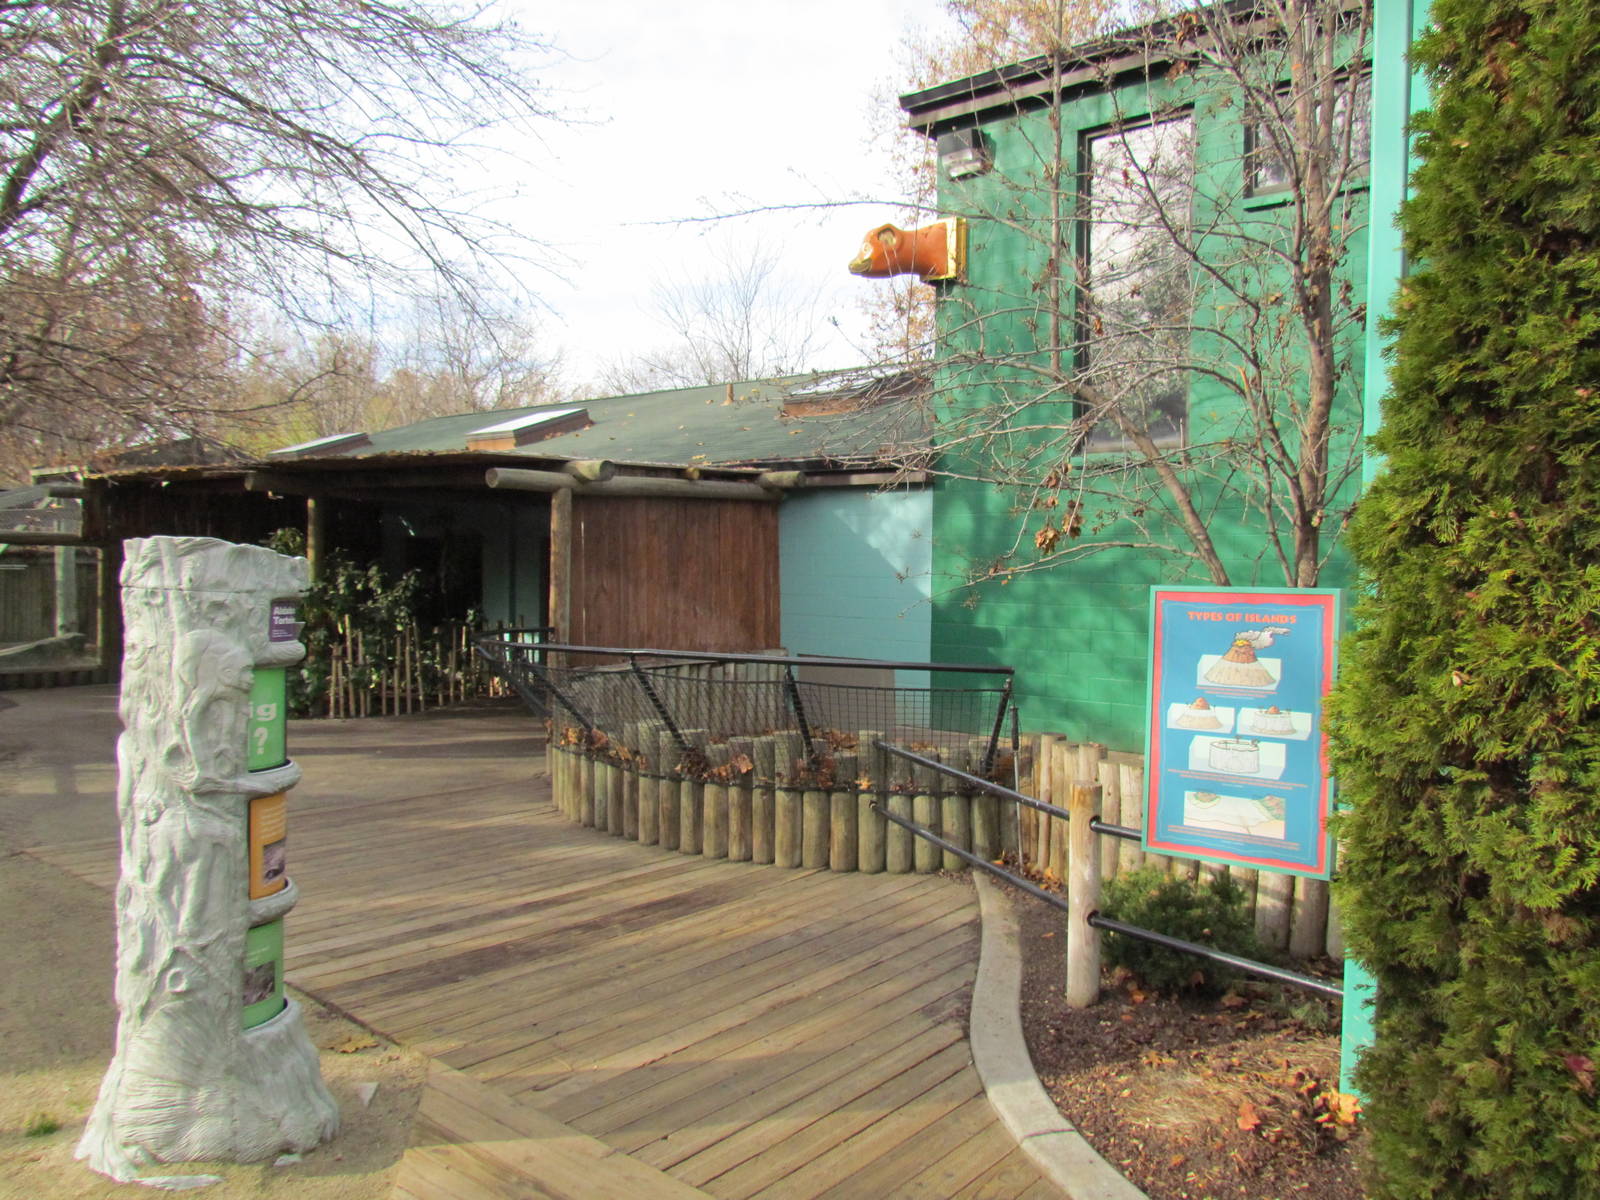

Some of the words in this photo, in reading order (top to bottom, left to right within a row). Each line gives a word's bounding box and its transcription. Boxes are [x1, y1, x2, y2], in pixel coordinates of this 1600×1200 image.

[1187, 611, 1223, 622] TYPES
[1225, 612, 1243, 623] OF
[1245, 613, 1297, 624] ISLANDS
[247, 701, 277, 721] ig
